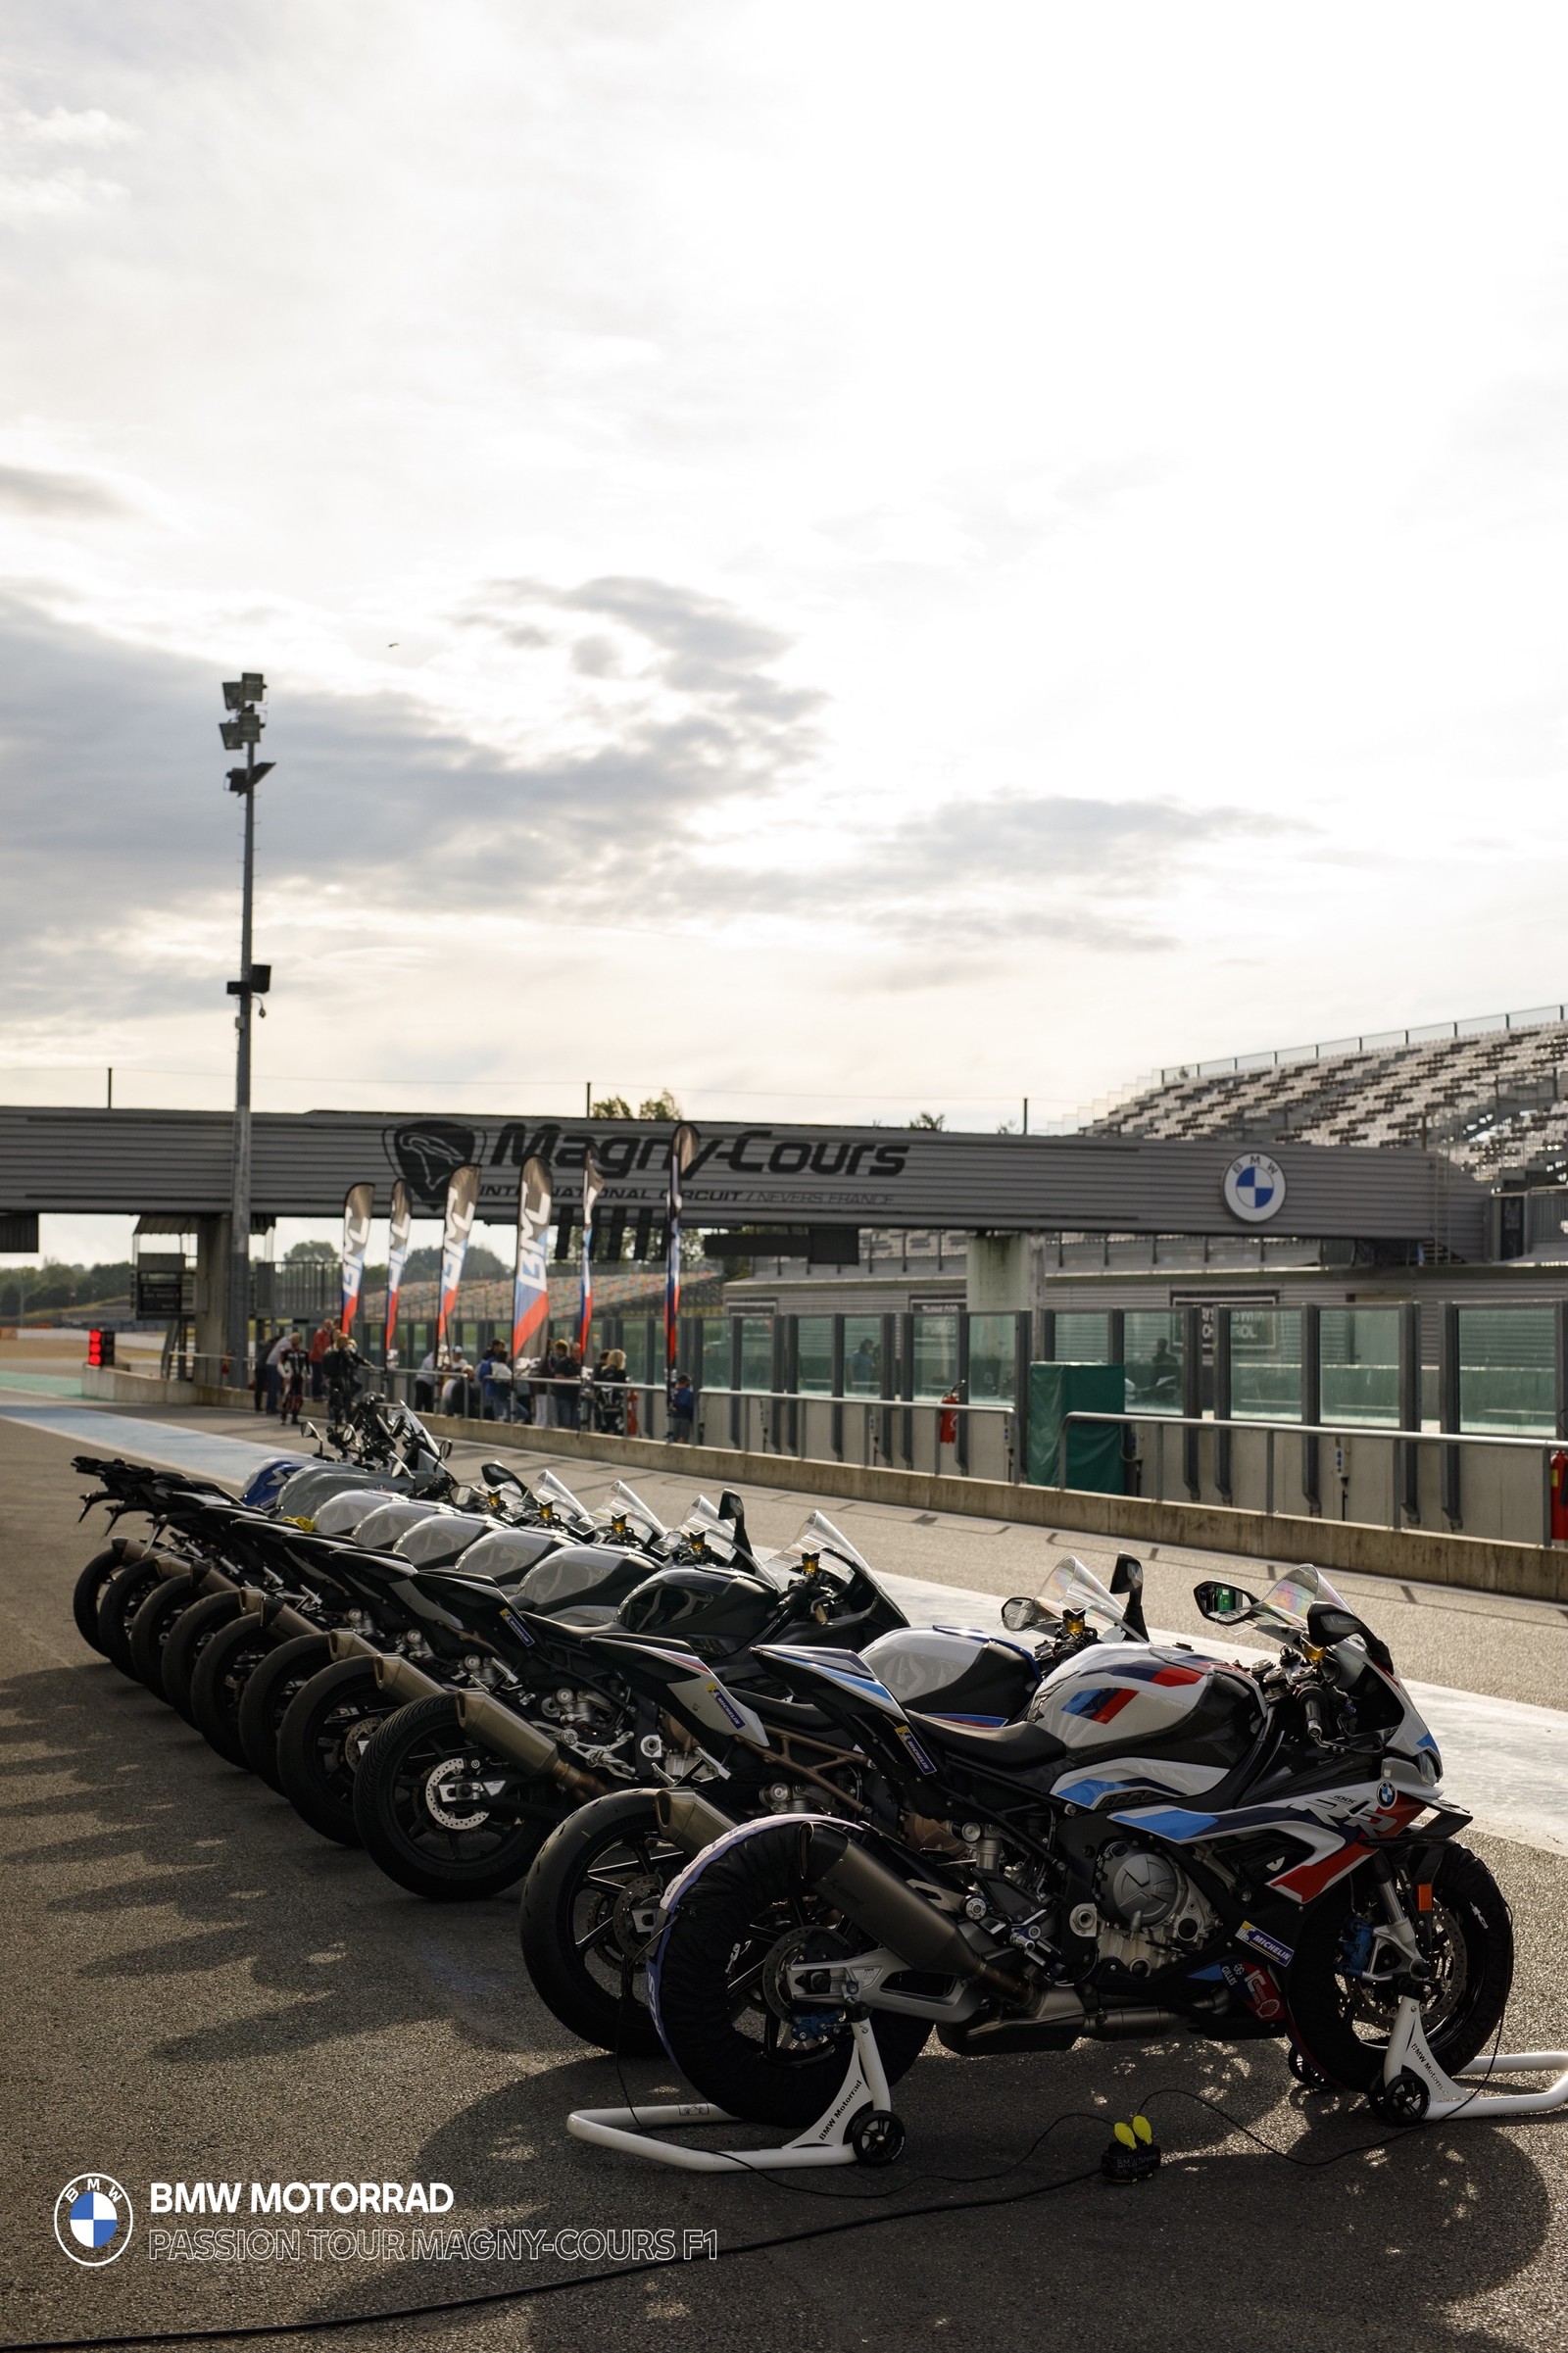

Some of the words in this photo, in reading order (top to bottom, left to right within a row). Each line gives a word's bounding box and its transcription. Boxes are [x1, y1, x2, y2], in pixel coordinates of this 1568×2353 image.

[490, 1122, 910, 1181] Magny-Cours
[1233, 1155, 1278, 1174] BMW
[660, 1188, 744, 1201] CRCUIT
[754, 1191, 823, 1203] NEVERS
[827, 1192, 895, 1206] FRANCE
[716, 1697, 741, 1725] MICHELIN
[907, 1740, 930, 1769] MICHELIN
[1252, 1935, 1292, 1961] MICHELIN
[1222, 1966, 1237, 1985] GILLES
[1411, 2042, 1427, 2063] BMW
[818, 2118, 836, 2140] BMW
[834, 2079, 862, 2118] Motorrad
